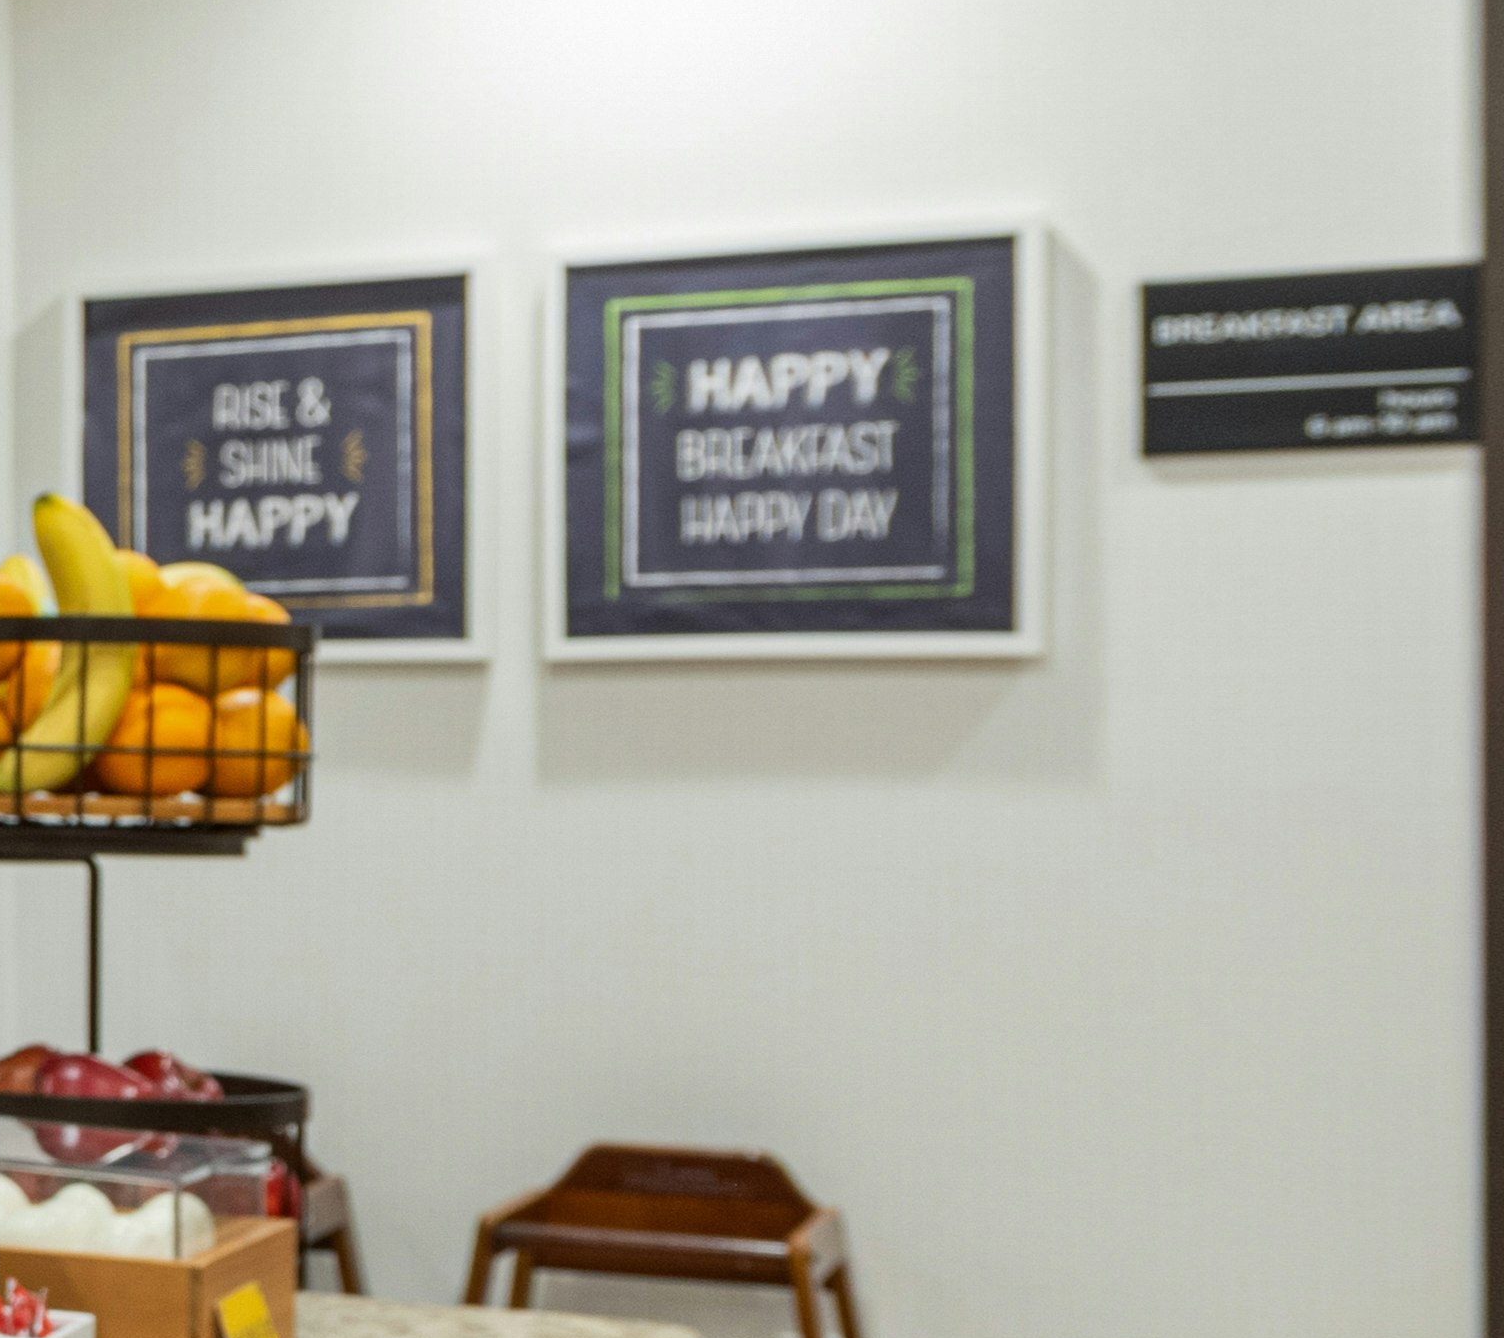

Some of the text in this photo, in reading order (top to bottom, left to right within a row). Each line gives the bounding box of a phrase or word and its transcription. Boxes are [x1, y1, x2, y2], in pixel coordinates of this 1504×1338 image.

[1151, 298, 1464, 347] BREAKFAST AREA
[212, 375, 332, 431] RISE &
[687, 346, 891, 415] HAPPY
[218, 434, 323, 489] SHINE
[676, 419, 900, 482] BREAKFAST
[187, 490, 361, 552] HAPPY
[680, 487, 899, 546] HAPPY DAY
